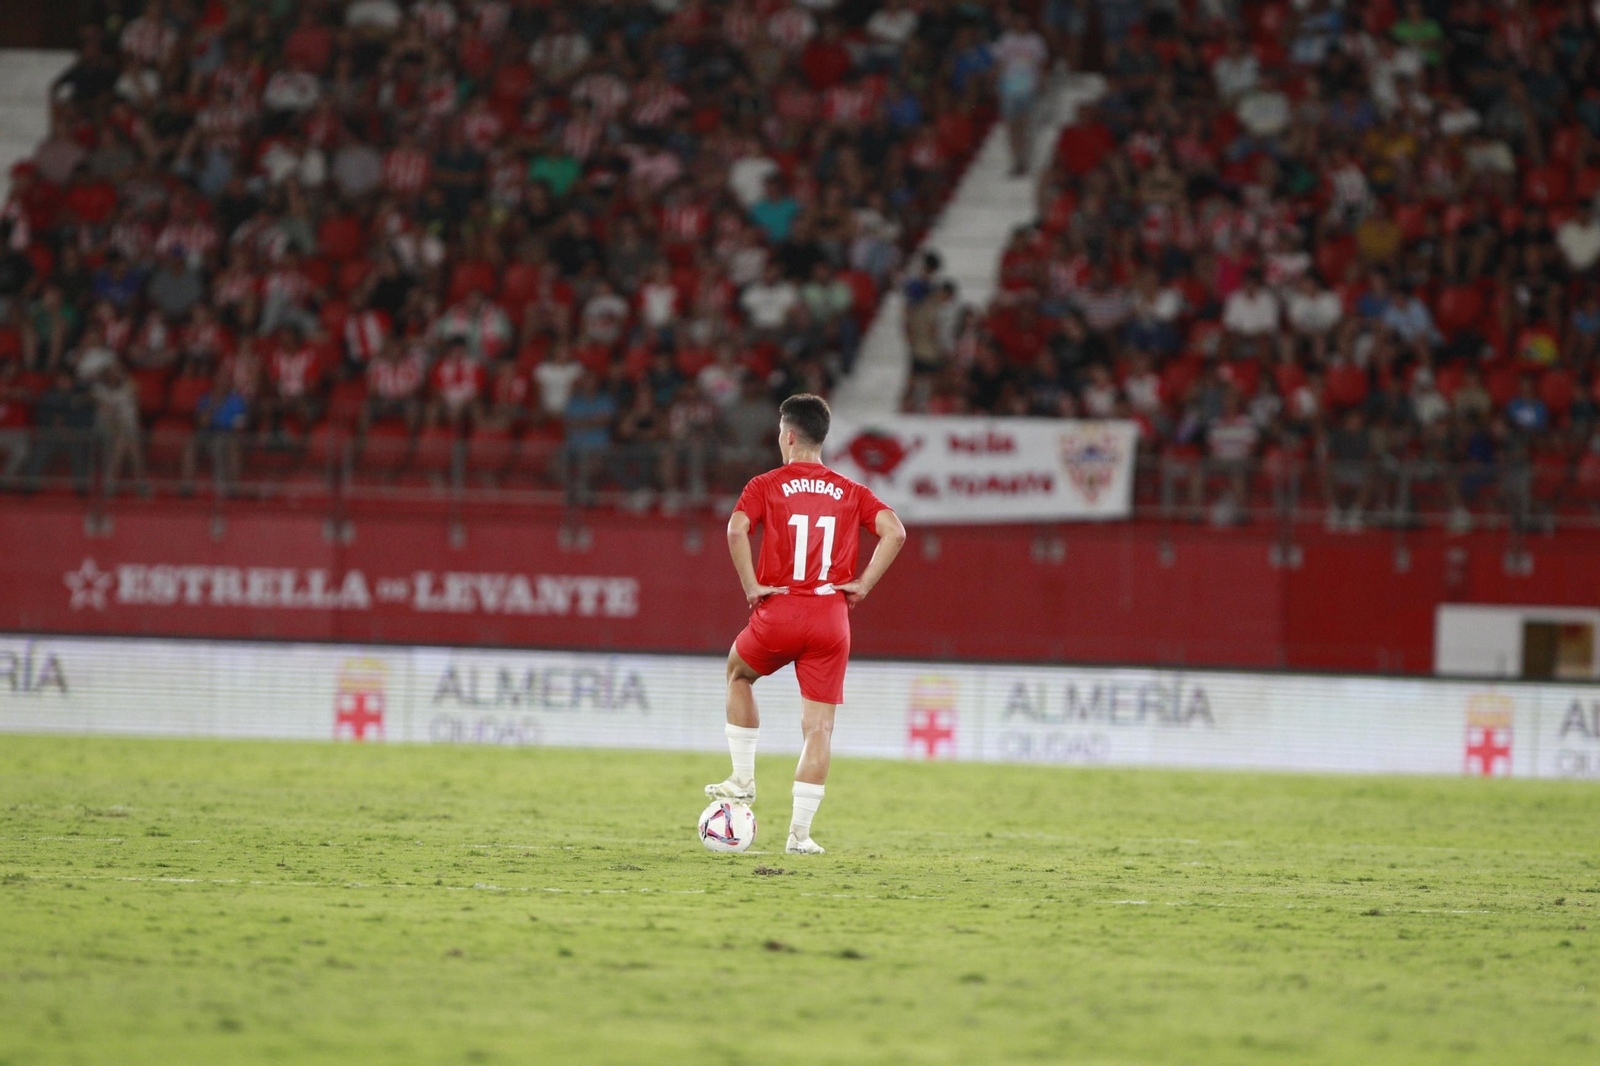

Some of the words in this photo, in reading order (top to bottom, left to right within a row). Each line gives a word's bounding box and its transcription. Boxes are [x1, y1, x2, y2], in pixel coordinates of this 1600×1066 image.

[781, 478, 844, 501] ARRIBAS
[788, 513, 836, 581] 11
[117, 565, 370, 610] ESTRELLA
[414, 570, 639, 617] LEVANTE
[432, 653, 649, 715] ALMERÍA
[1003, 669, 1213, 727] ALMERÍA
